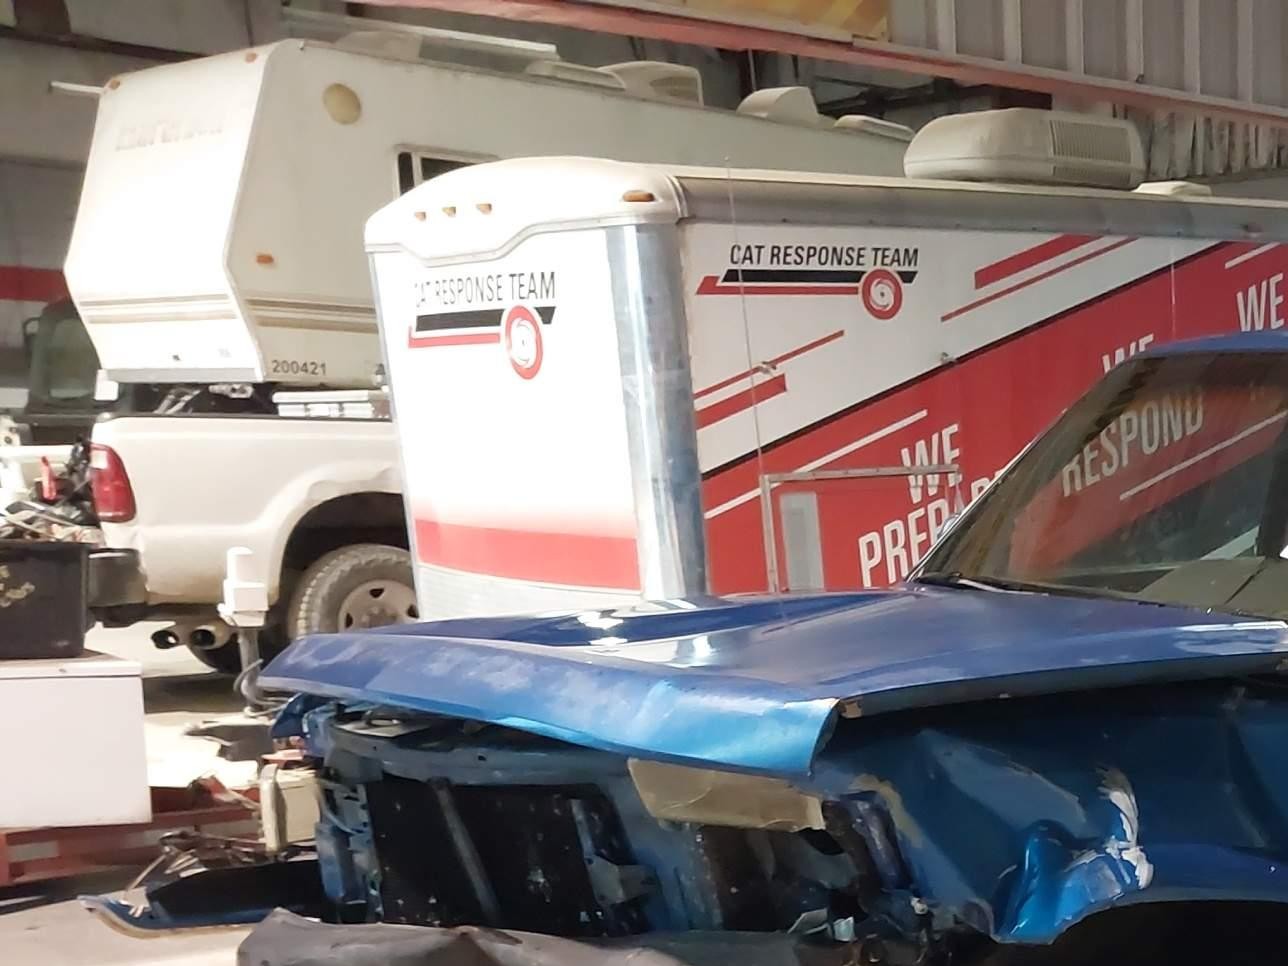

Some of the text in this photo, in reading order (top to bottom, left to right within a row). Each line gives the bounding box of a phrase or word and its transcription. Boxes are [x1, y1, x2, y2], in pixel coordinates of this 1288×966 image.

[732, 244, 919, 267] CAT RESPONSE TEAM
[508, 271, 556, 301] TEAM
[1236, 272, 1285, 332] WE
[271, 359, 327, 376] 200421
[901, 423, 962, 504] WE
